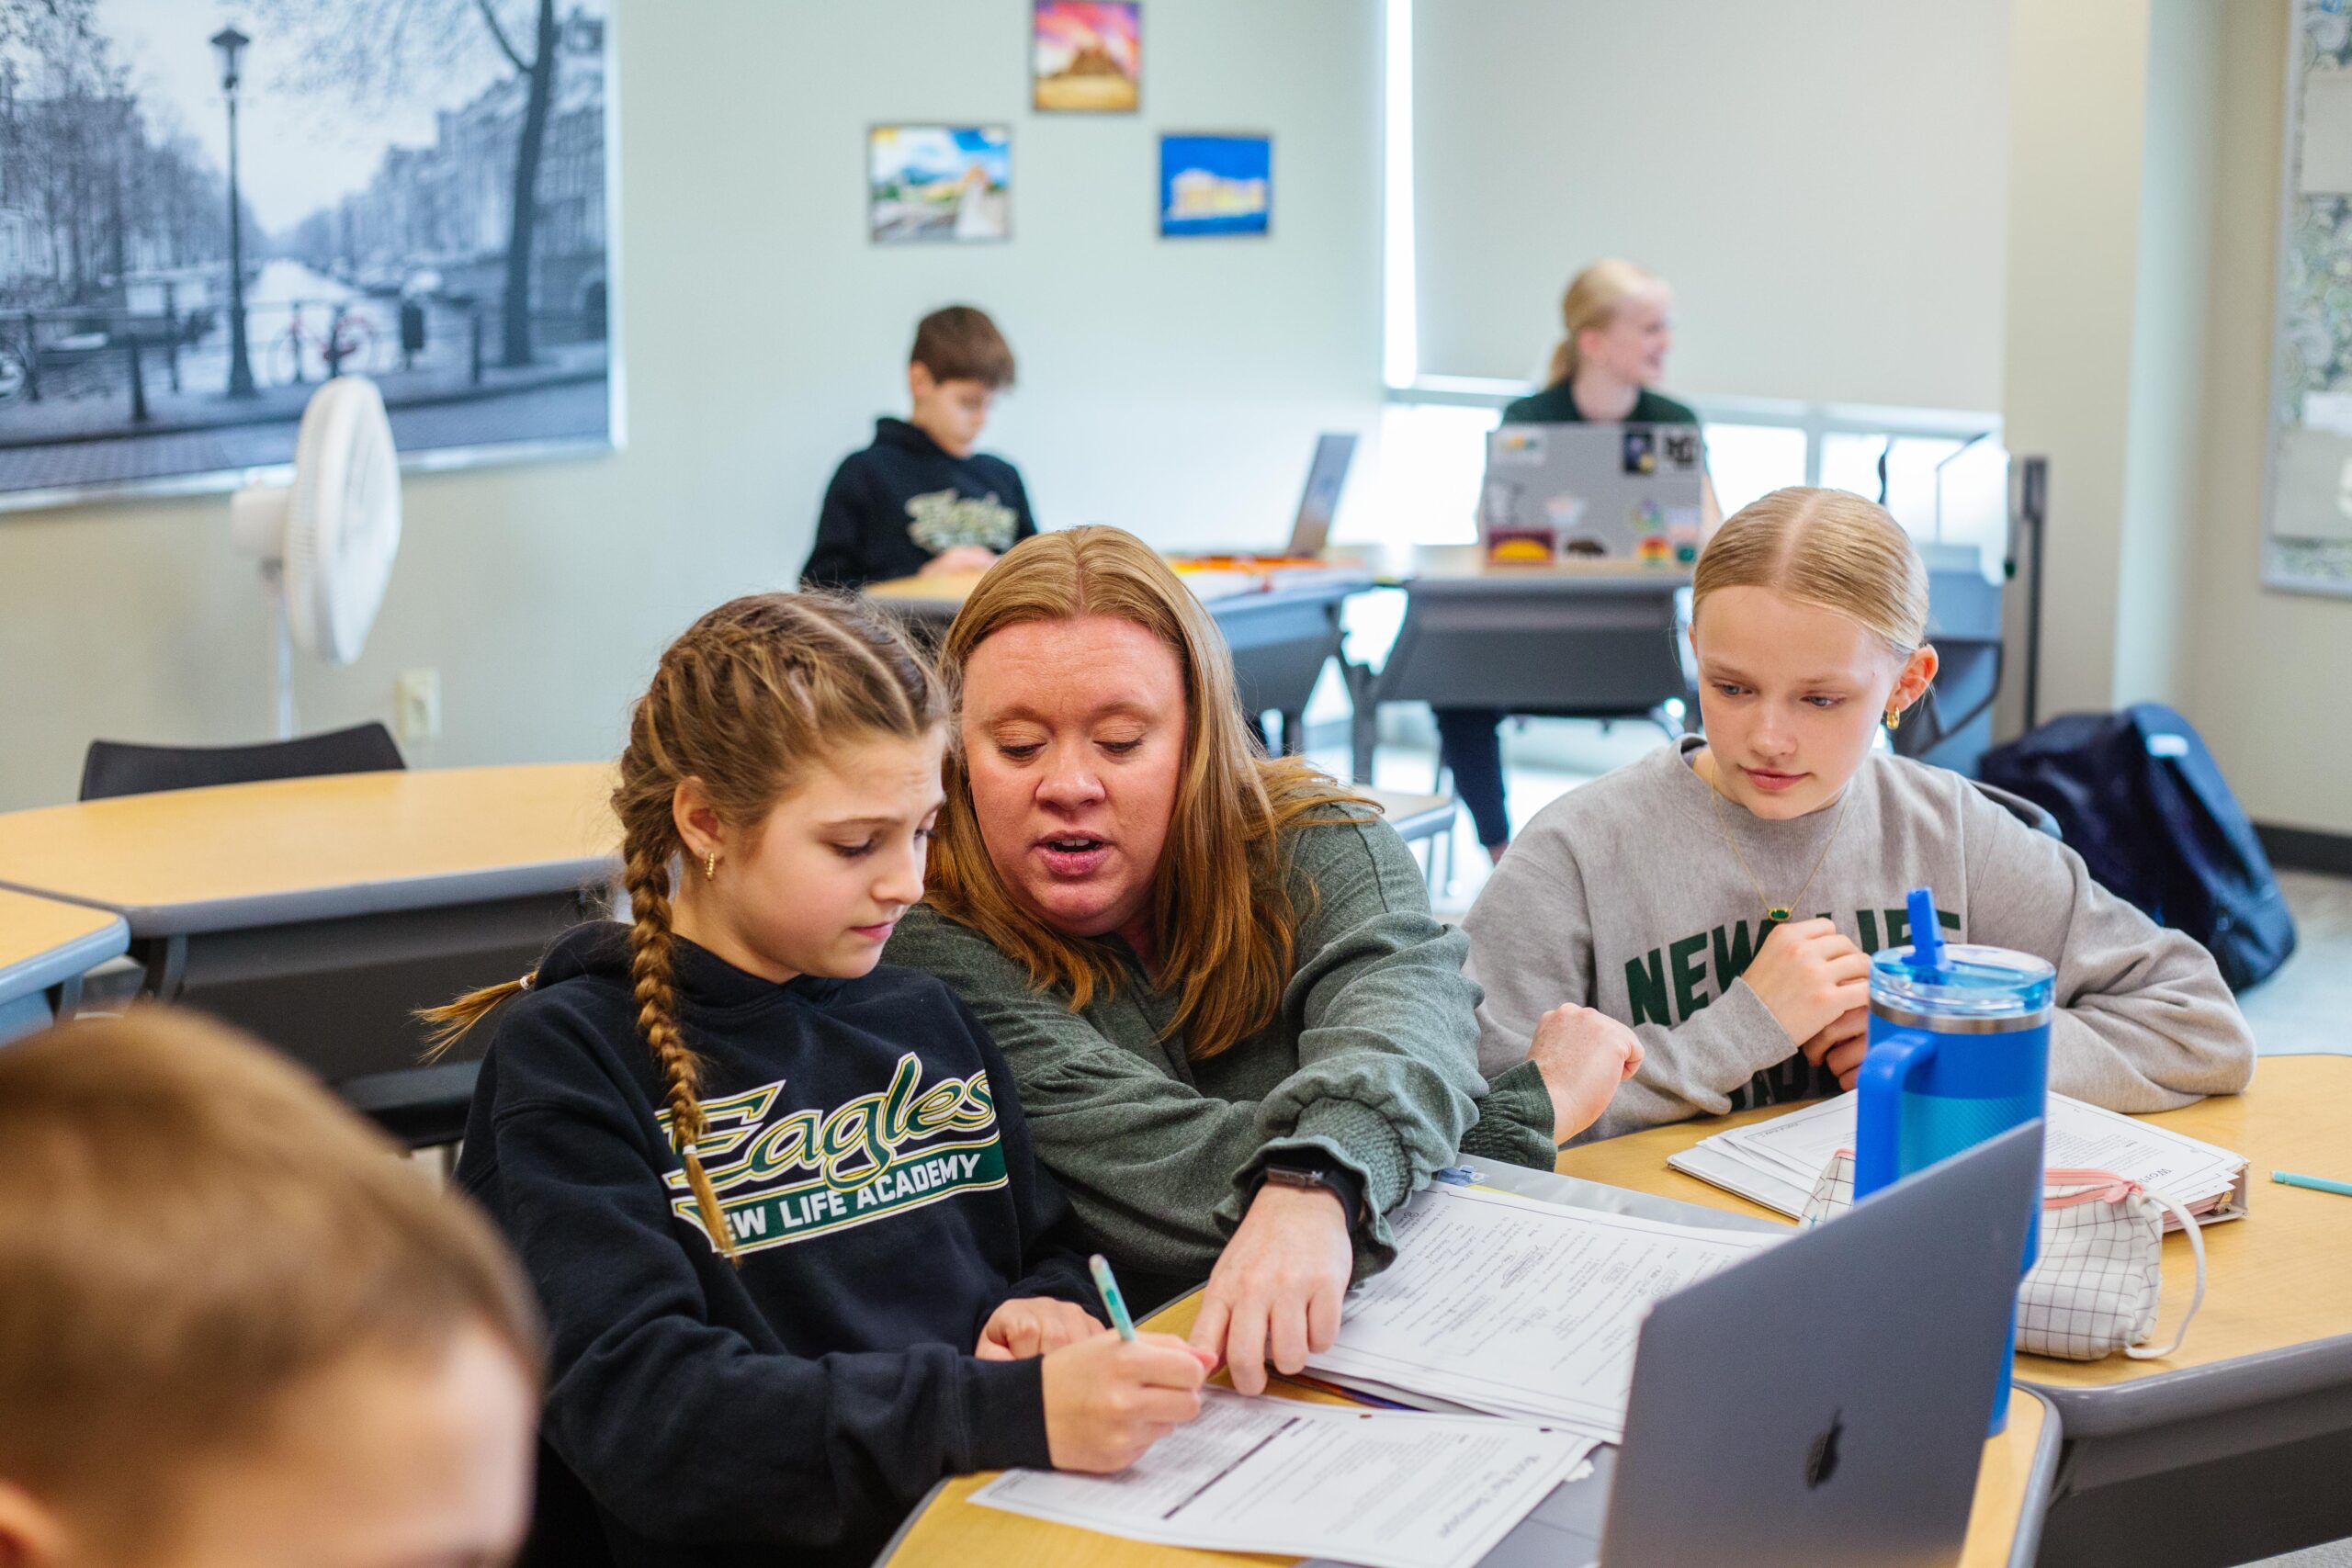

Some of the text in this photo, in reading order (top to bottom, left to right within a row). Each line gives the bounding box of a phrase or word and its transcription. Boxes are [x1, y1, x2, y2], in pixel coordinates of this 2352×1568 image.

[1624, 919, 1781, 1027] NEW
[654, 1051, 997, 1192] Eagles
[722, 1153, 981, 1241] EW LIFE ACADEMY
